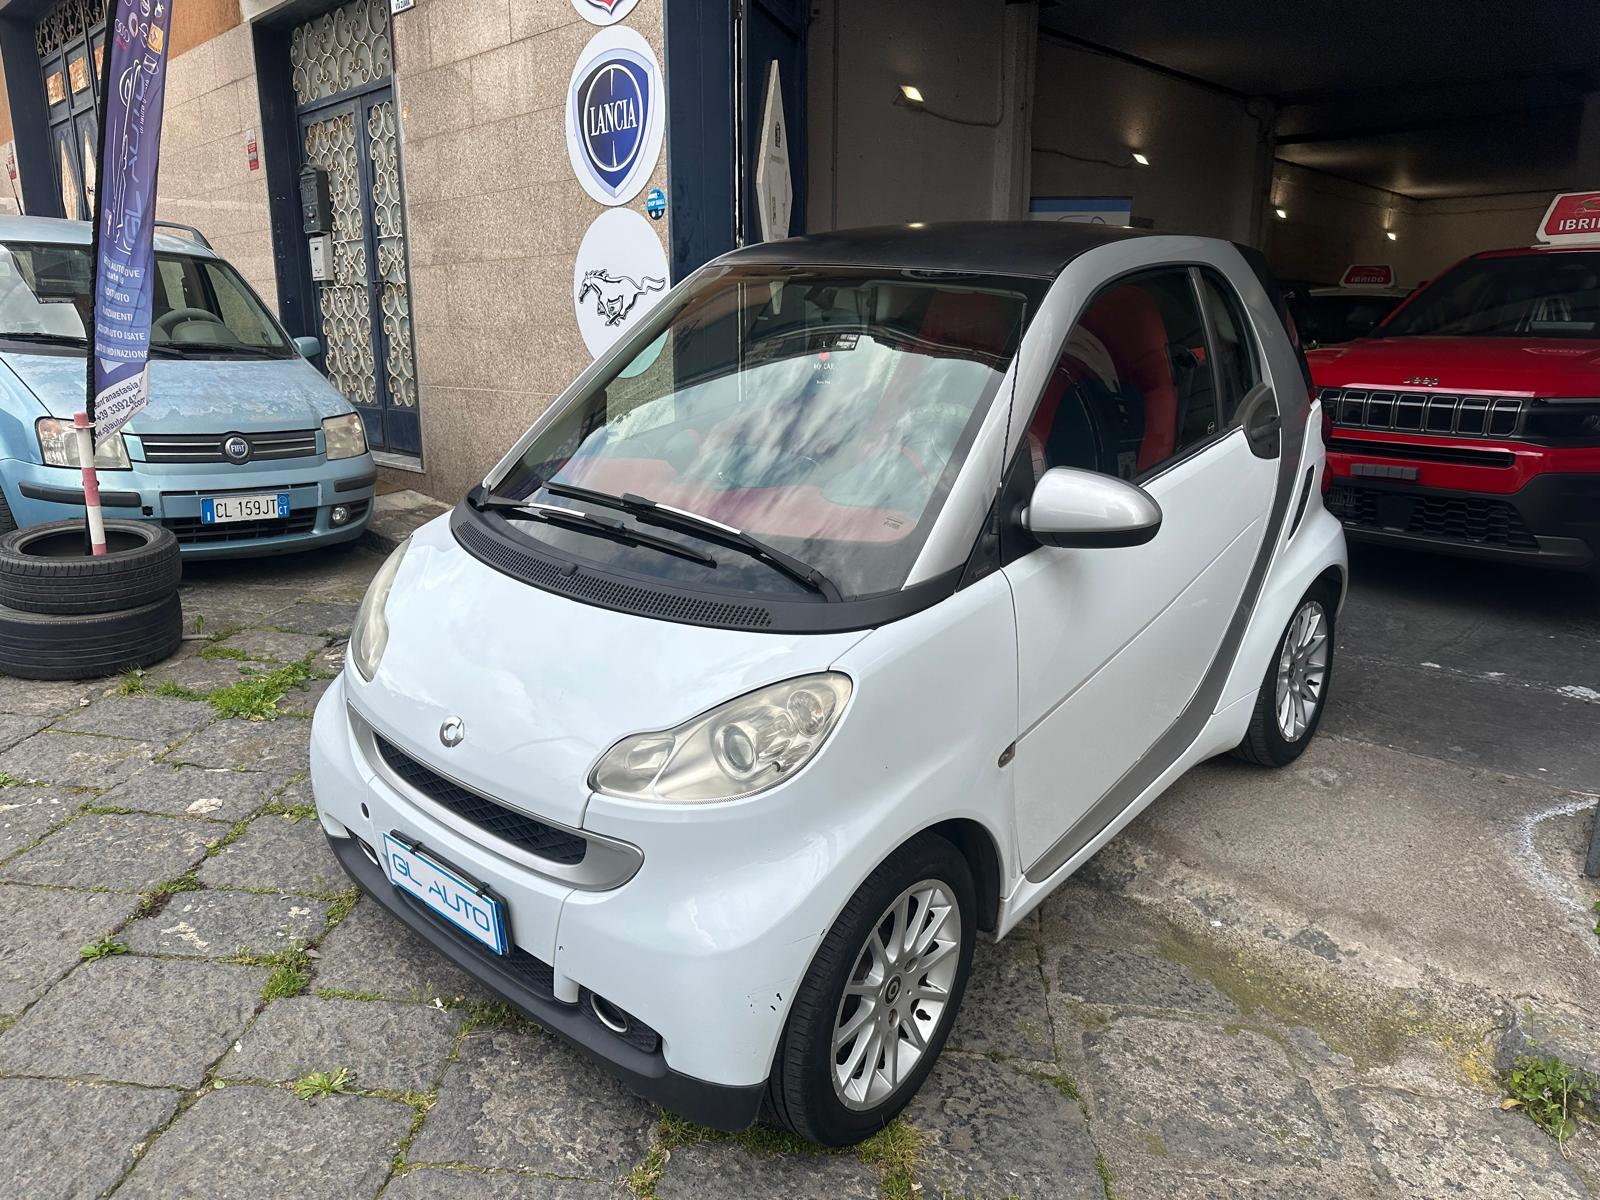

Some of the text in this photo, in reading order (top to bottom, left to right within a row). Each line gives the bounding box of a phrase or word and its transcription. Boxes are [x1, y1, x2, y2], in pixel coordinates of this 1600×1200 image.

[590, 97, 638, 136] LANCIA
[1558, 217, 1600, 231] IBRI
[1402, 376, 1440, 387] Jeep
[231, 445, 245, 453] FIAT
[215, 499, 277, 518] CL 159JT
[278, 505, 287, 515] CT
[392, 853, 490, 932] GL AUTO
